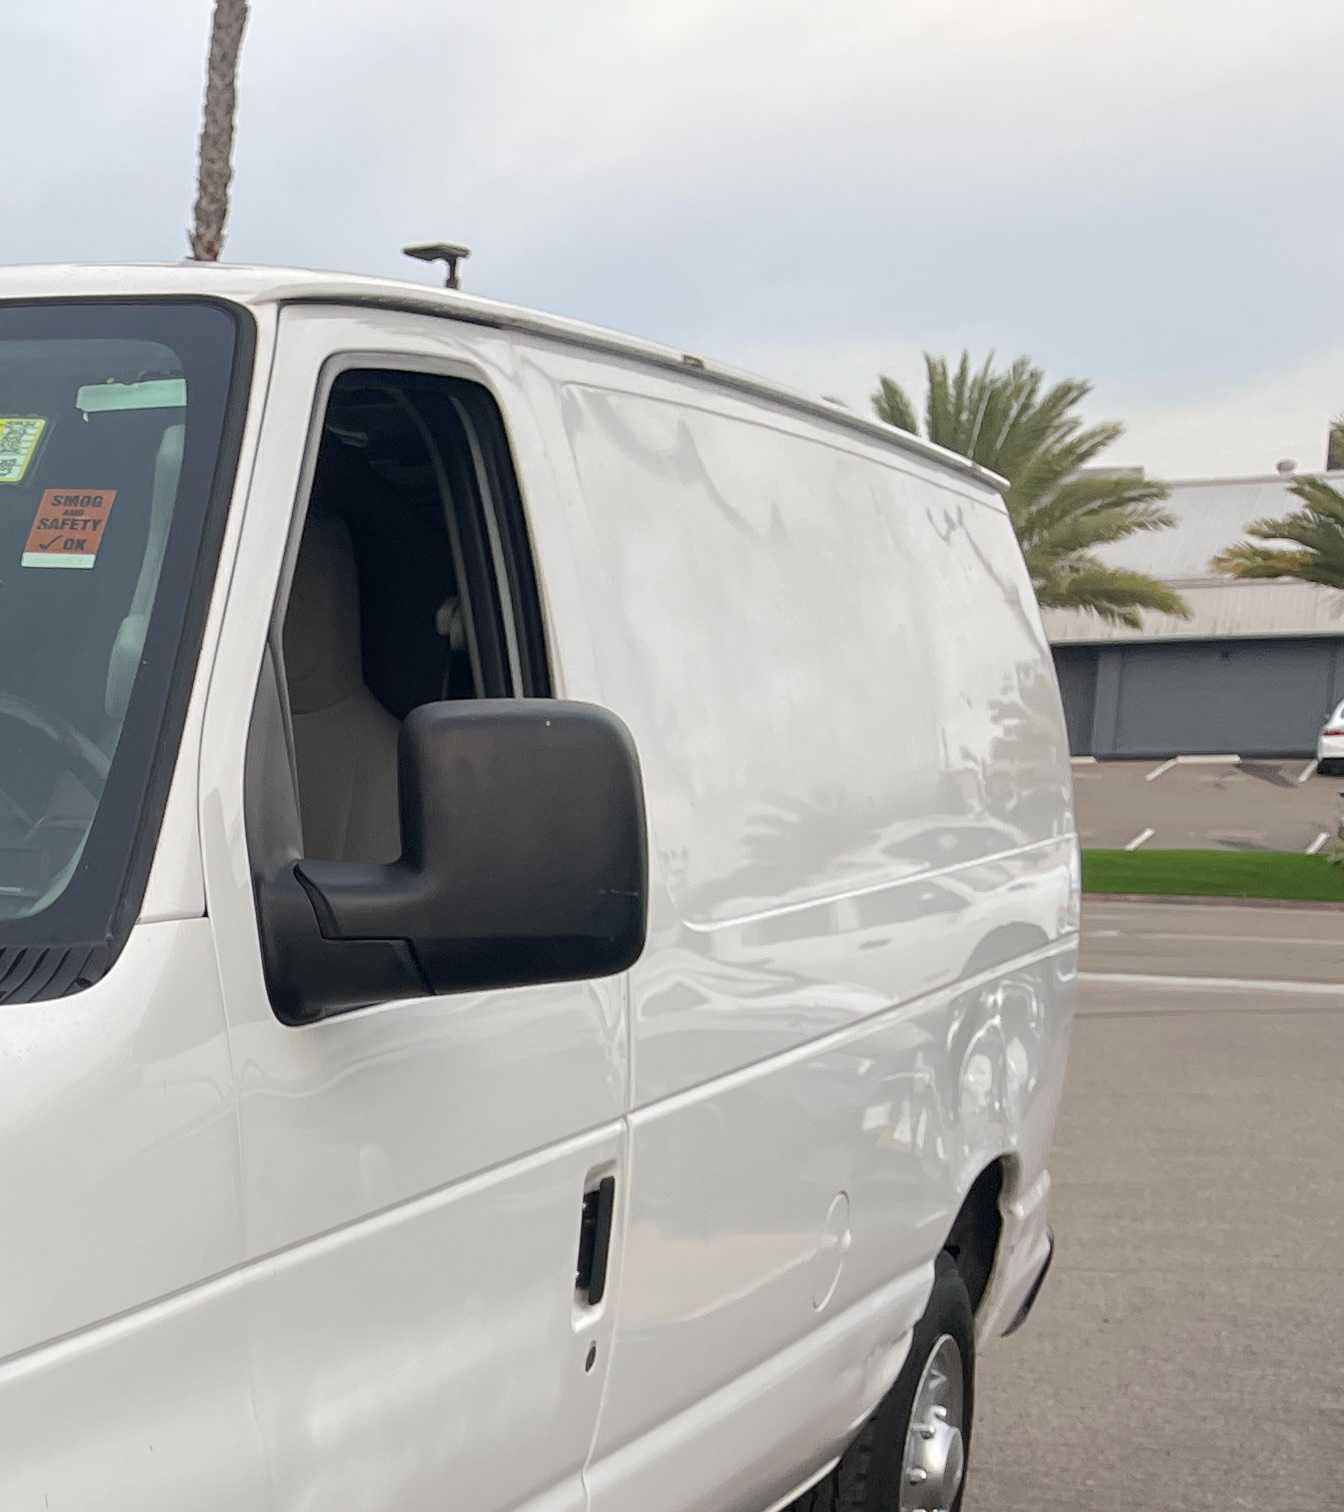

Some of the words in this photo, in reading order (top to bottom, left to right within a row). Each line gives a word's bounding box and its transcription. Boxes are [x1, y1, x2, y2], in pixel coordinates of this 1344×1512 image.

[51, 495, 103, 507] SMOG
[37, 518, 102, 531] SAFETY
[64, 538, 88, 550] OK
